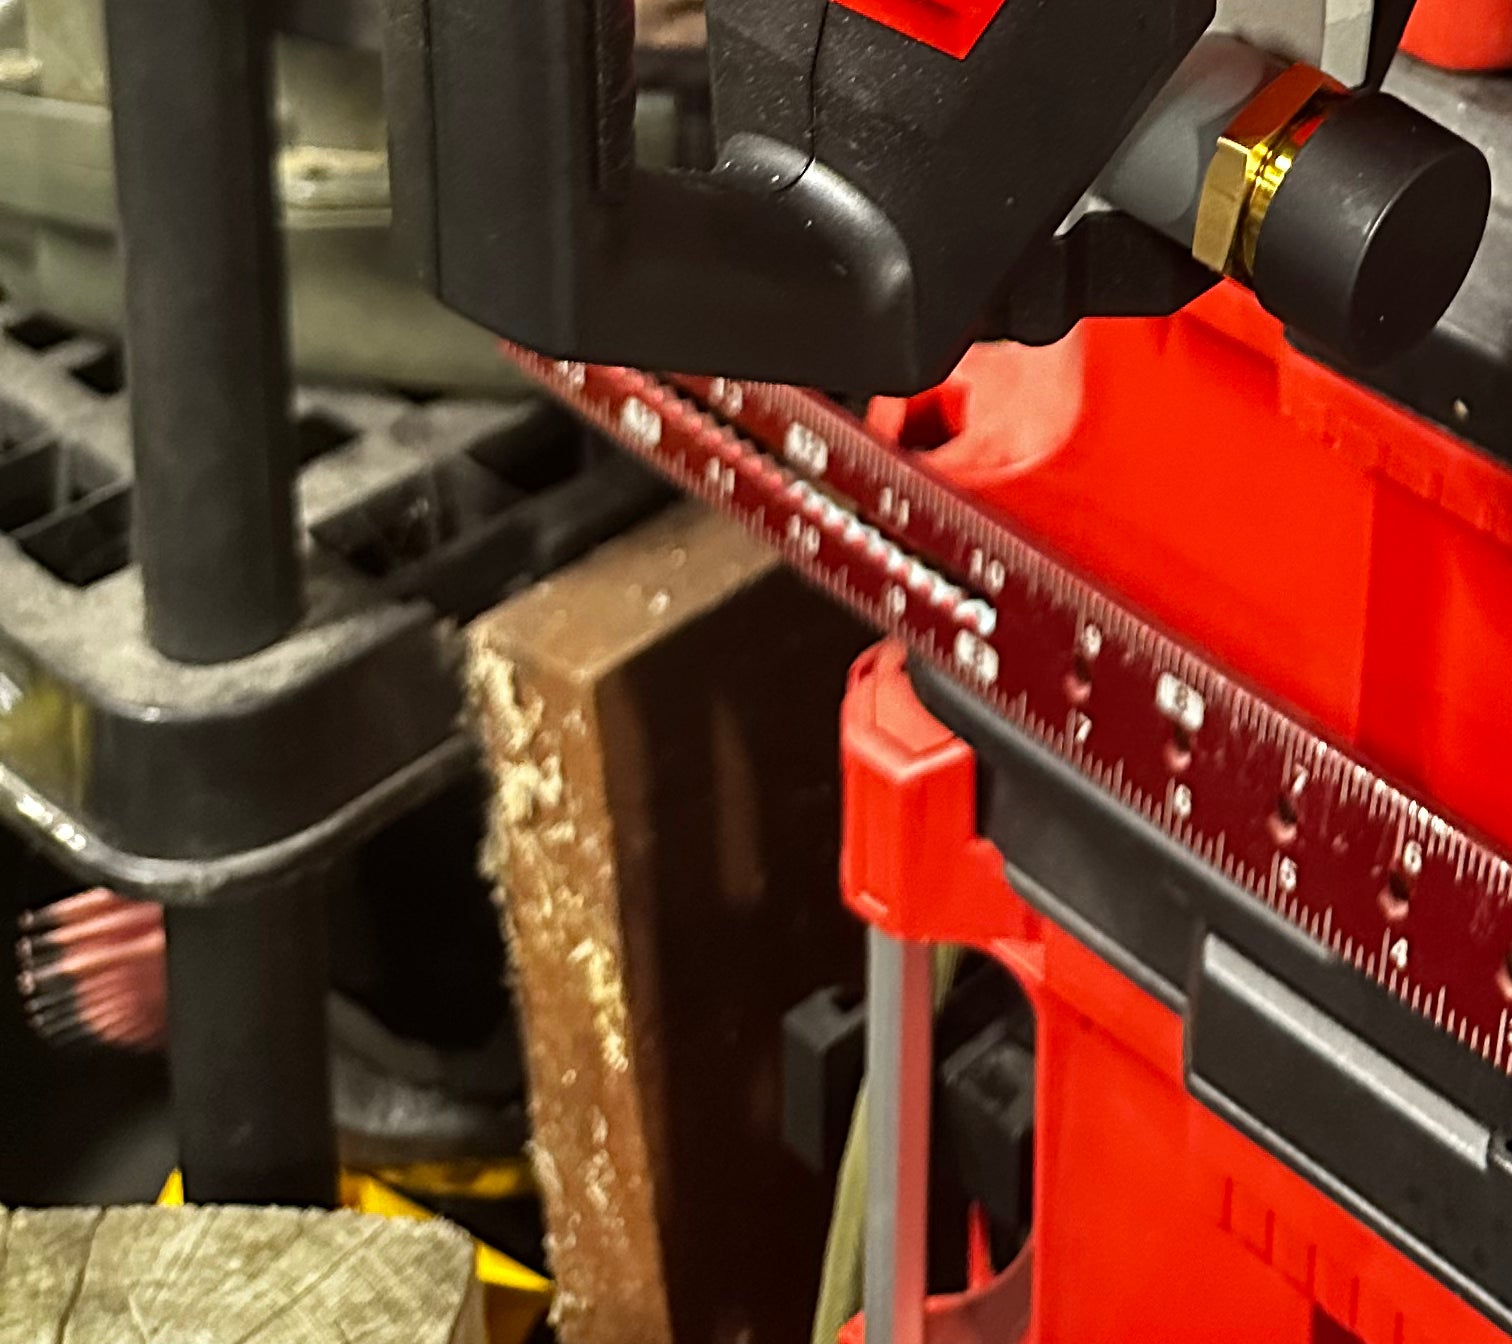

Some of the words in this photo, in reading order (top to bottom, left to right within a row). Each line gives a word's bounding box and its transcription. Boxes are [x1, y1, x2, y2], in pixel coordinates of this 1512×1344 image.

[1294, 763, 1308, 795] 7
[1403, 840, 1422, 873] 6
[1390, 937, 1408, 970] 4
